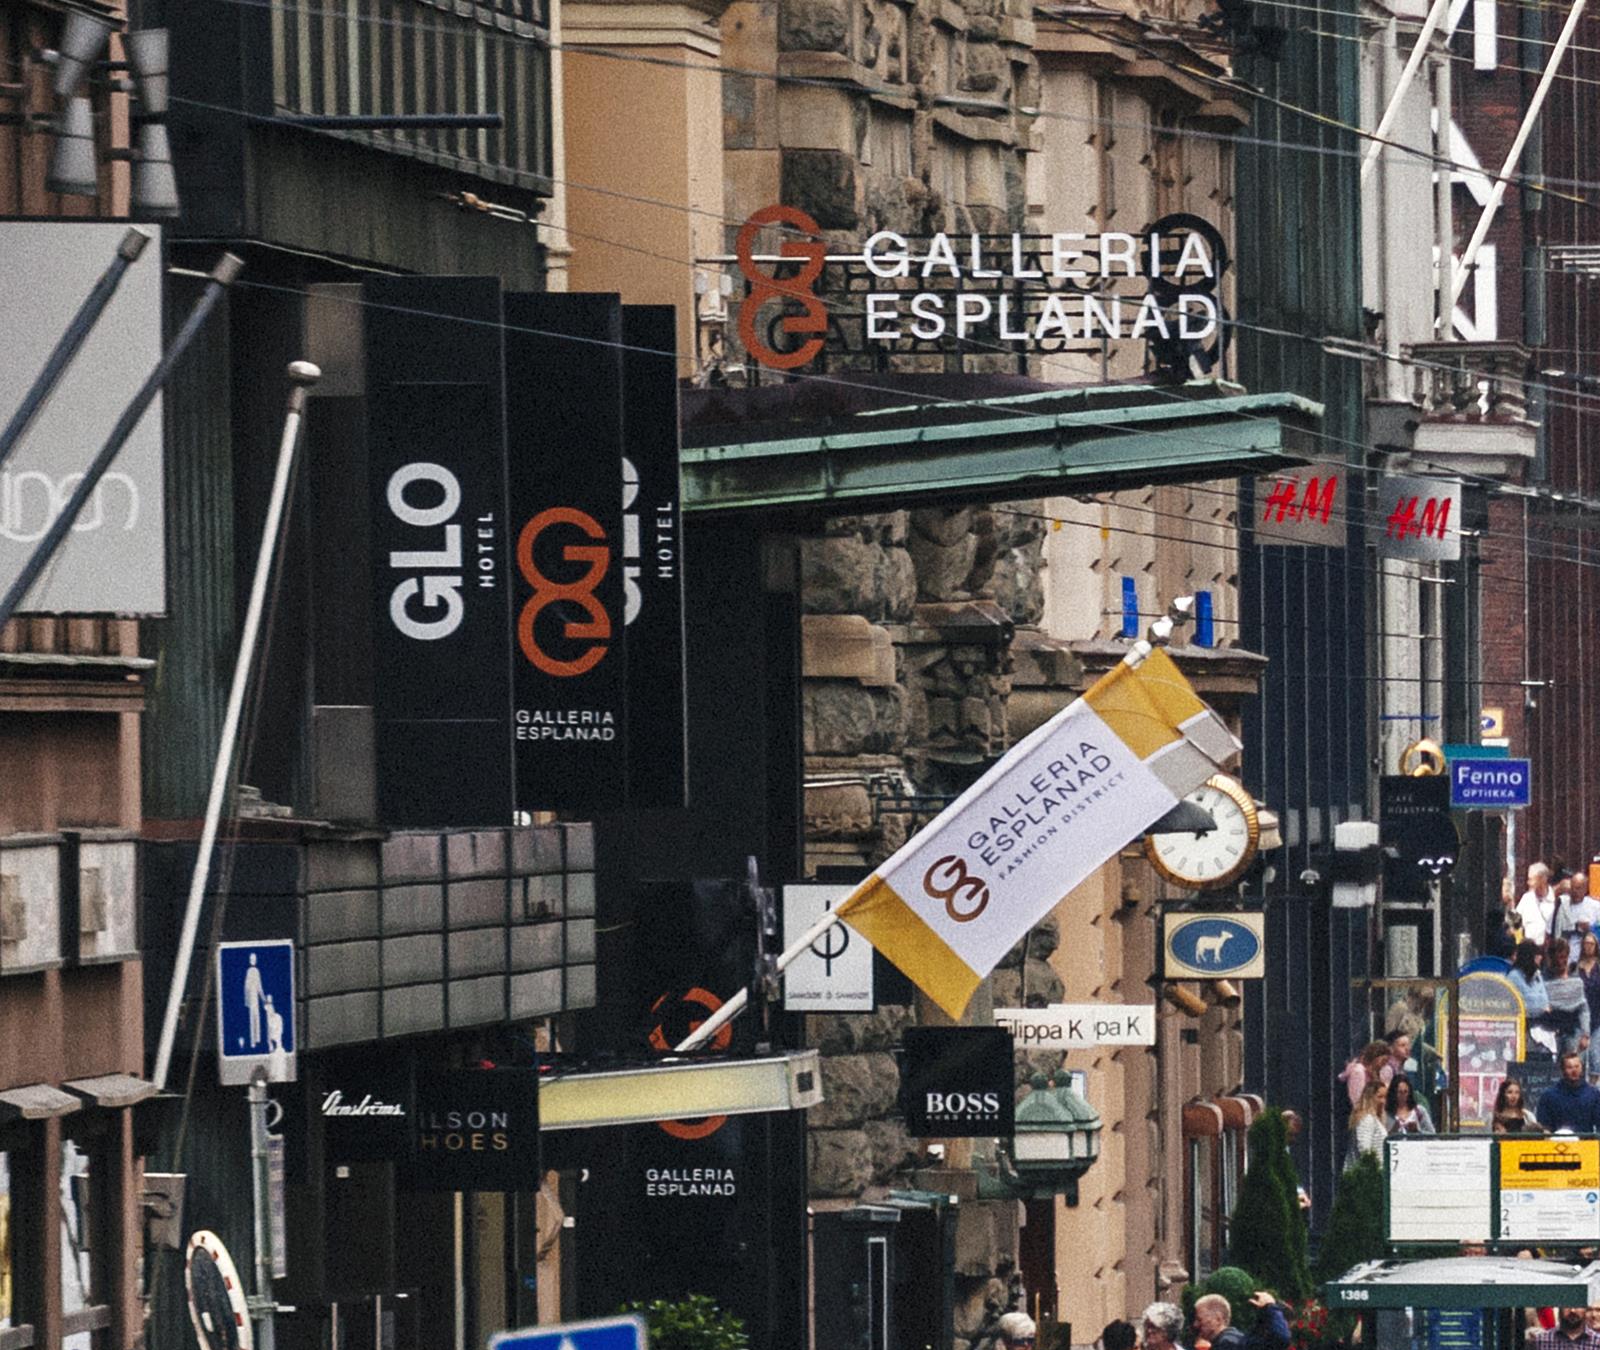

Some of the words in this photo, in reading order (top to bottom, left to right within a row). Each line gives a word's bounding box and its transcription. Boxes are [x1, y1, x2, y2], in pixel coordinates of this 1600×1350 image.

[863, 230, 1215, 279] GALLERIA
[866, 293, 1218, 341] ESPLANAD
[1263, 474, 1338, 526] H&M
[1386, 496, 1452, 541] H&M
[386, 462, 465, 641] GLO
[478, 512, 495, 588] HOTEL
[657, 502, 673, 578] HOTEL
[516, 709, 614, 724] GALLERIA
[516, 726, 615, 741] ESPLANAD
[967, 741, 1098, 850] GALLERIA
[1458, 766, 1523, 785] Fenno
[980, 755, 1112, 867] ESPLANAD
[999, 826, 1058, 880] FASHION
[1062, 771, 1126, 824] DISTRICT
[1068, 1019, 1084, 1041] K
[926, 1092, 1000, 1114] BOSS
[420, 1133, 508, 1151] HOES
[646, 1168, 735, 1182] GALLERIA
[646, 1183, 736, 1197] ESPLANAD
